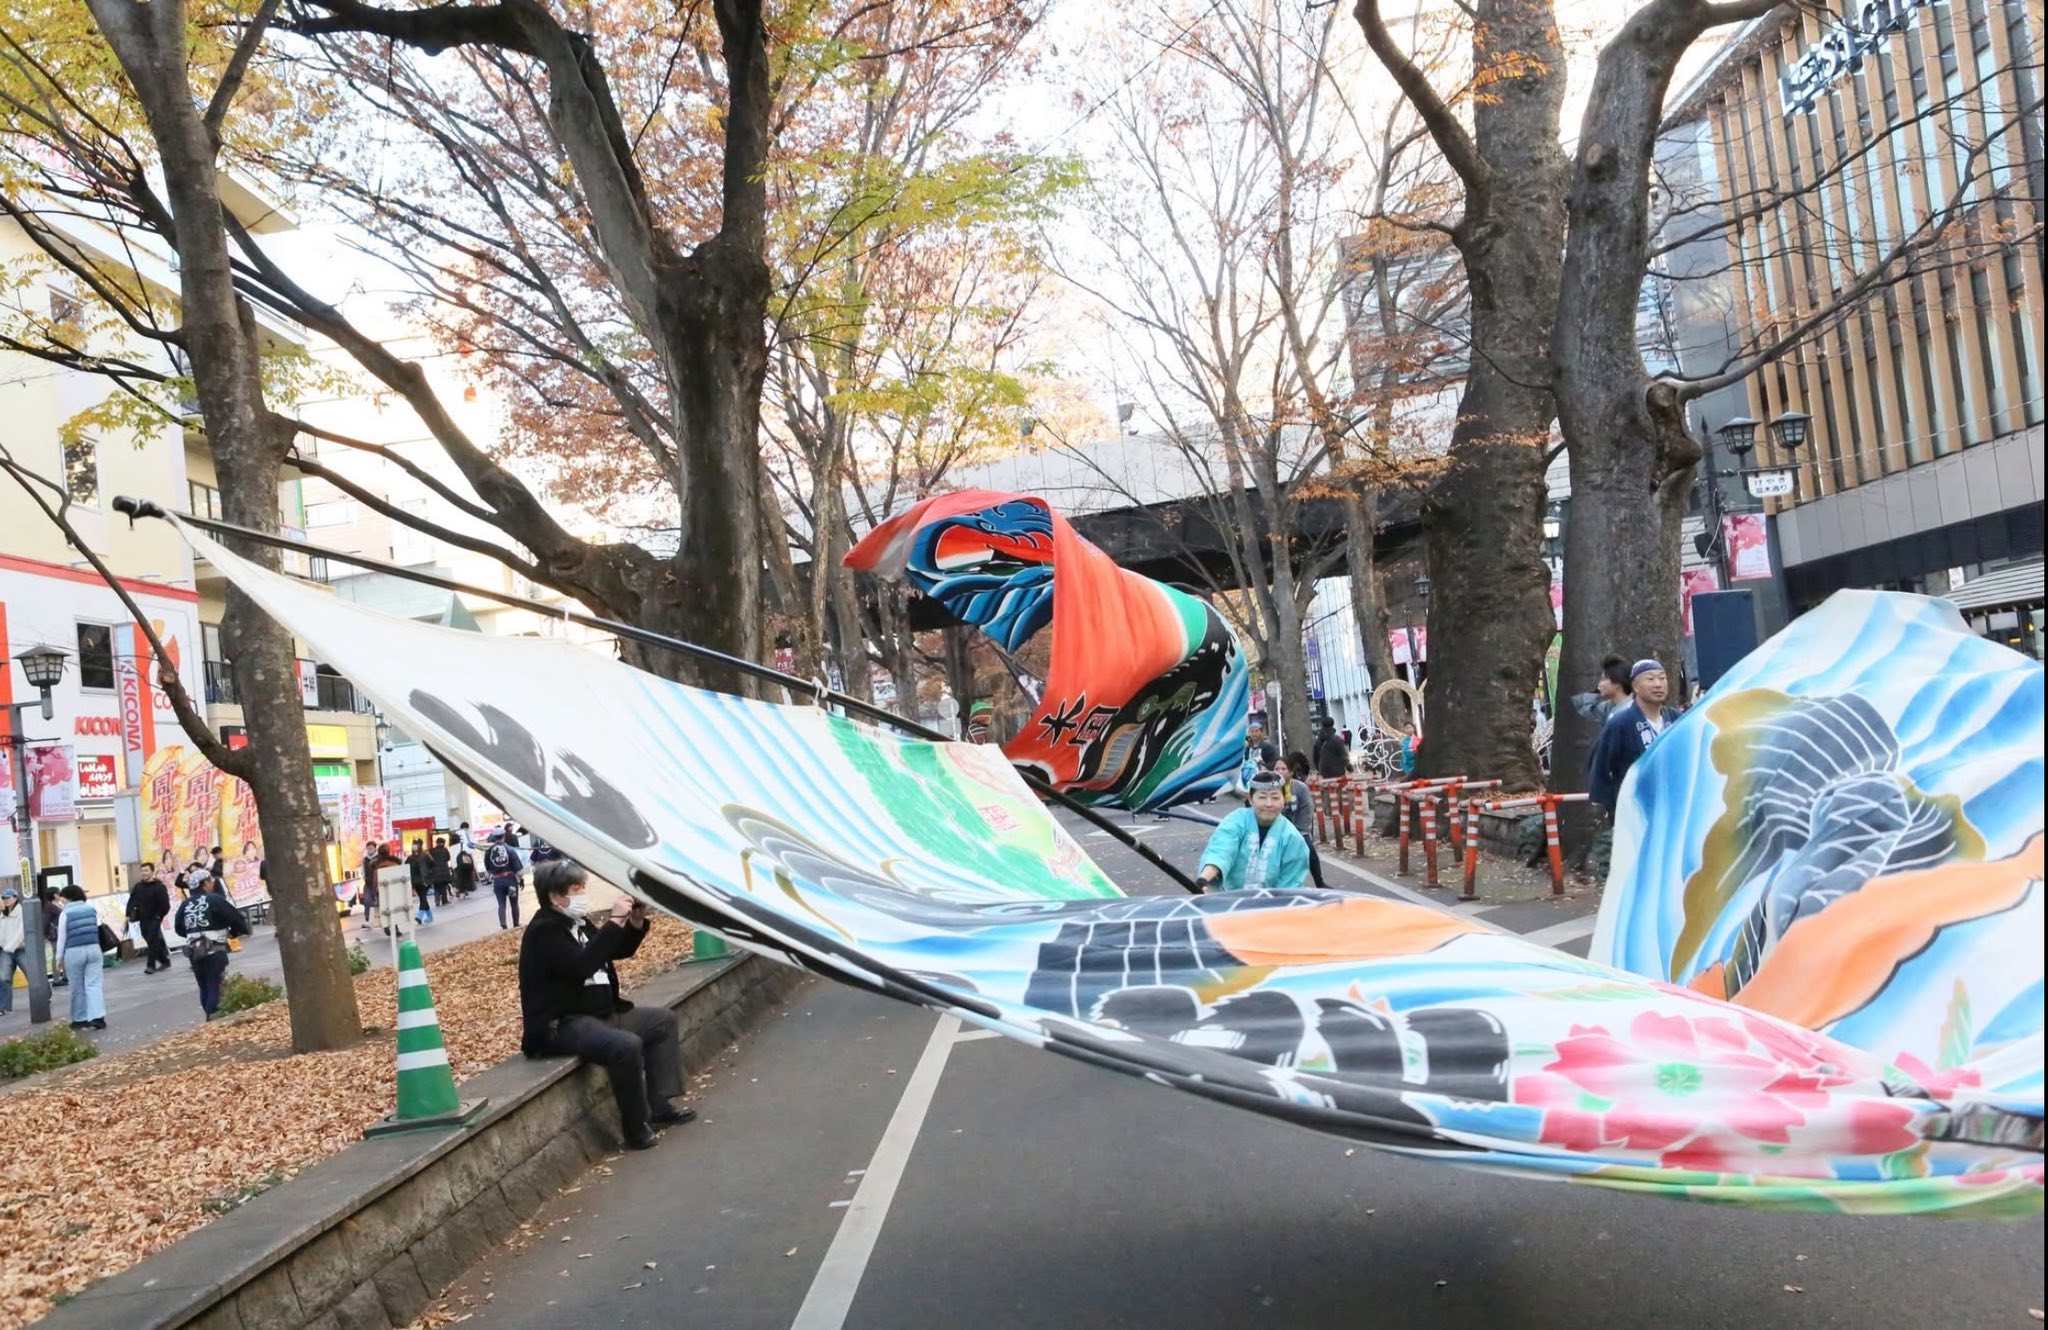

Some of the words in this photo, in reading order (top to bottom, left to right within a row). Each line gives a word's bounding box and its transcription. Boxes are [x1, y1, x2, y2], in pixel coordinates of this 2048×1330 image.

[1754, 476, 1786, 487] けやき
[1756, 484, 1788, 494] 並木通り
[123, 677, 141, 752] KICONA
[74, 715, 123, 736] KICON
